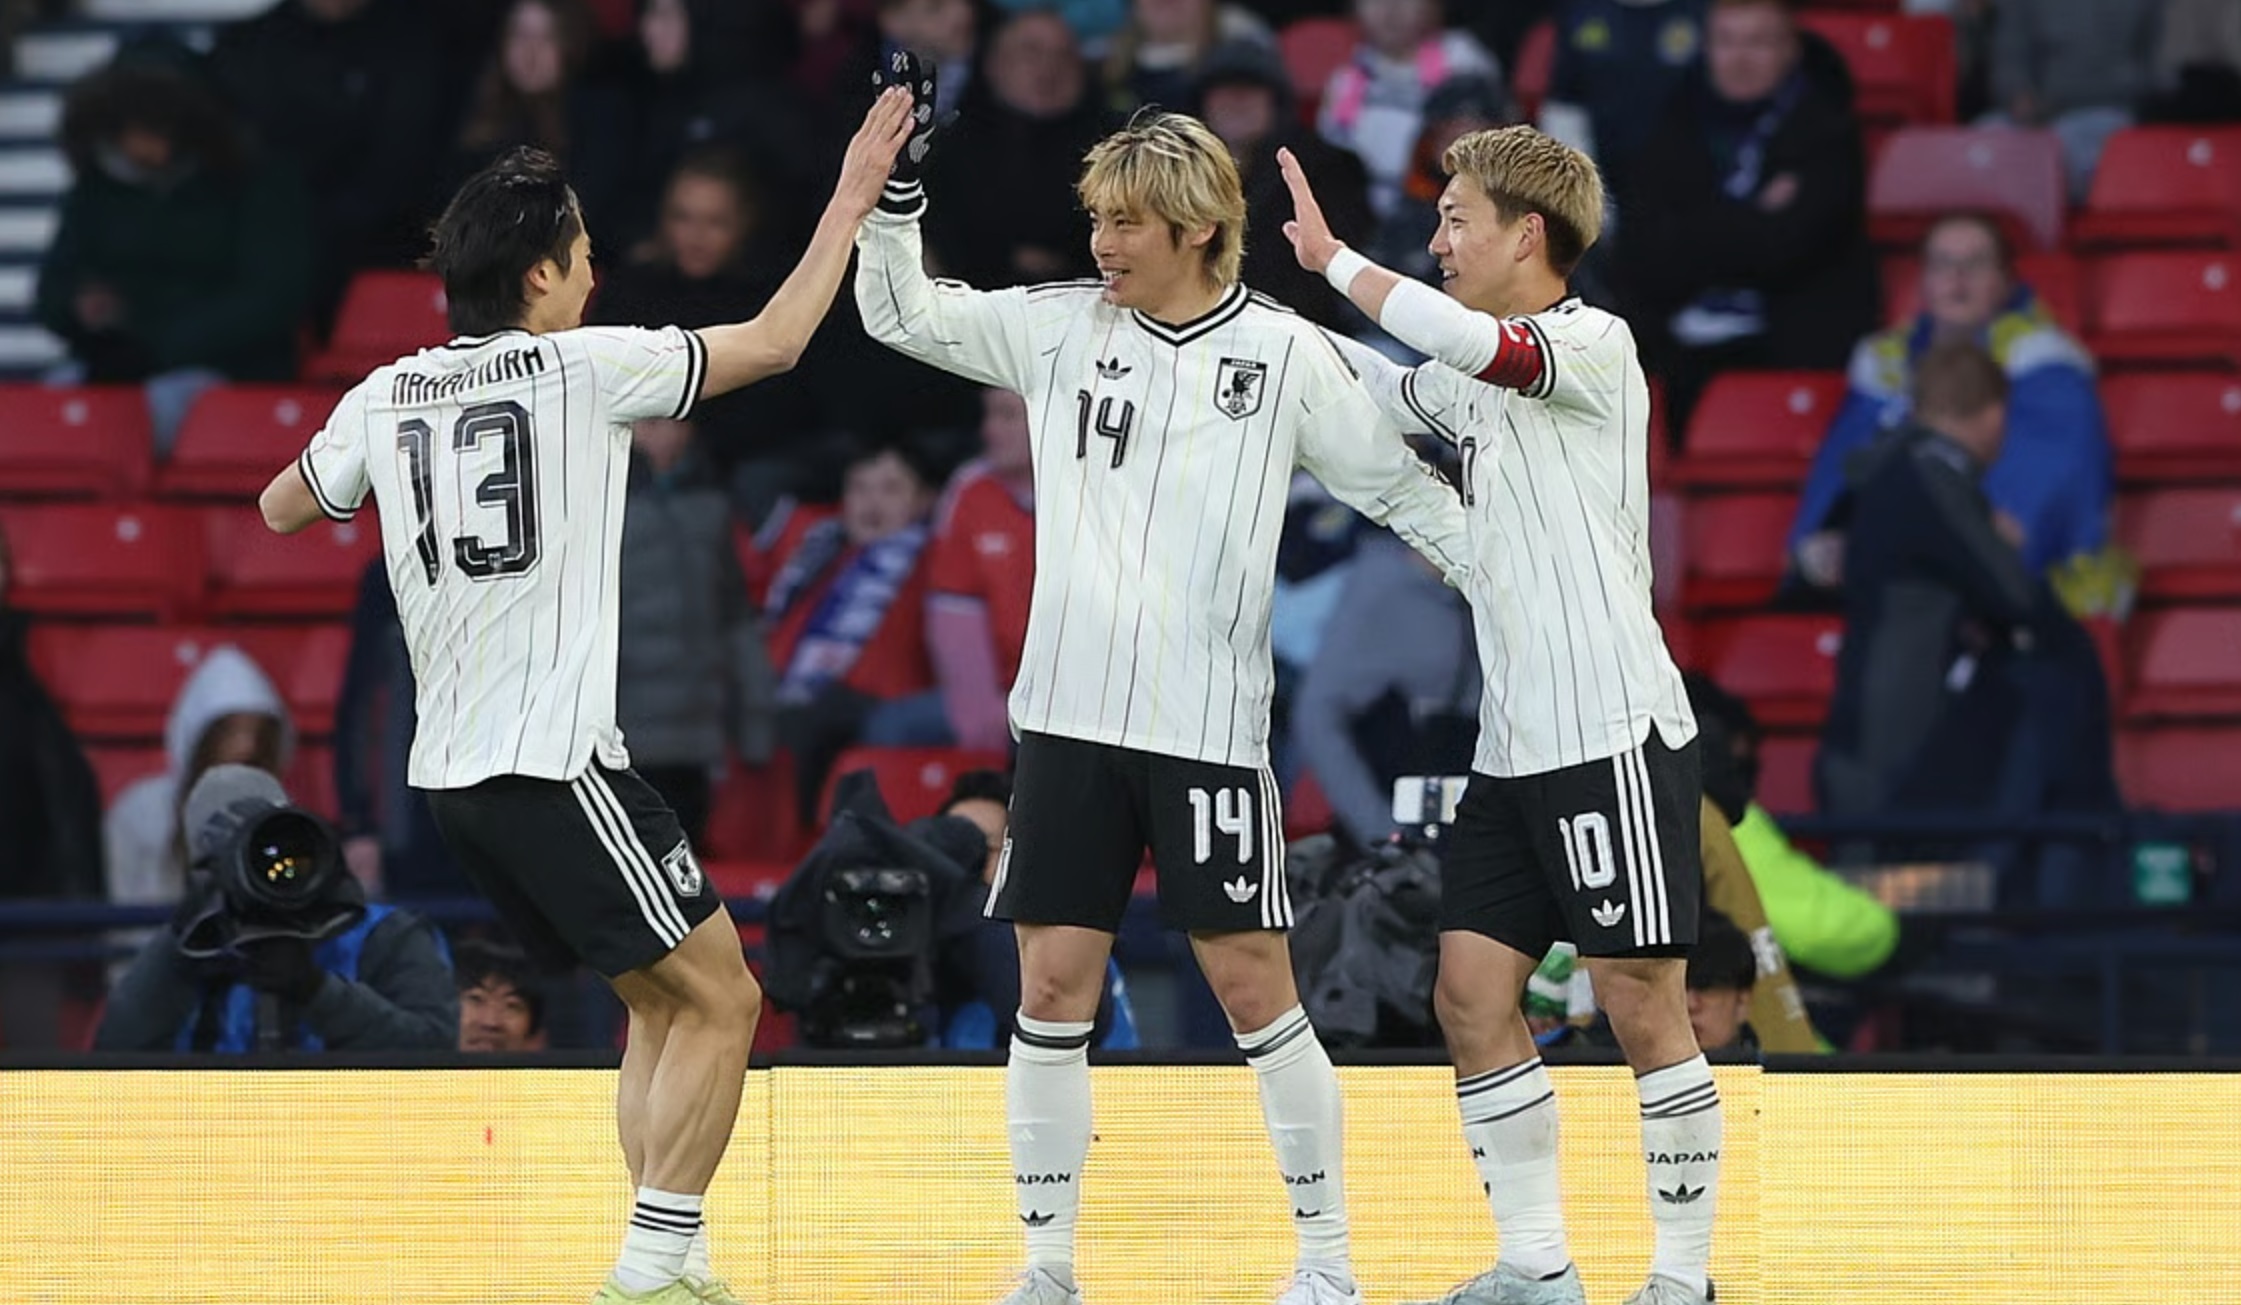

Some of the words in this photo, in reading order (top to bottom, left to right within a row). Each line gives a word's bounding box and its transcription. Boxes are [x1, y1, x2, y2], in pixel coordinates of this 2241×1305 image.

[1076, 388, 1136, 470] 14
[397, 400, 542, 586] 13
[1187, 787, 1254, 865] 14
[1557, 811, 1618, 893] 10
[1015, 1171, 1072, 1185] APAN
[1280, 1169, 1326, 1186] PAN
[1646, 1150, 1719, 1165] JAPAN
